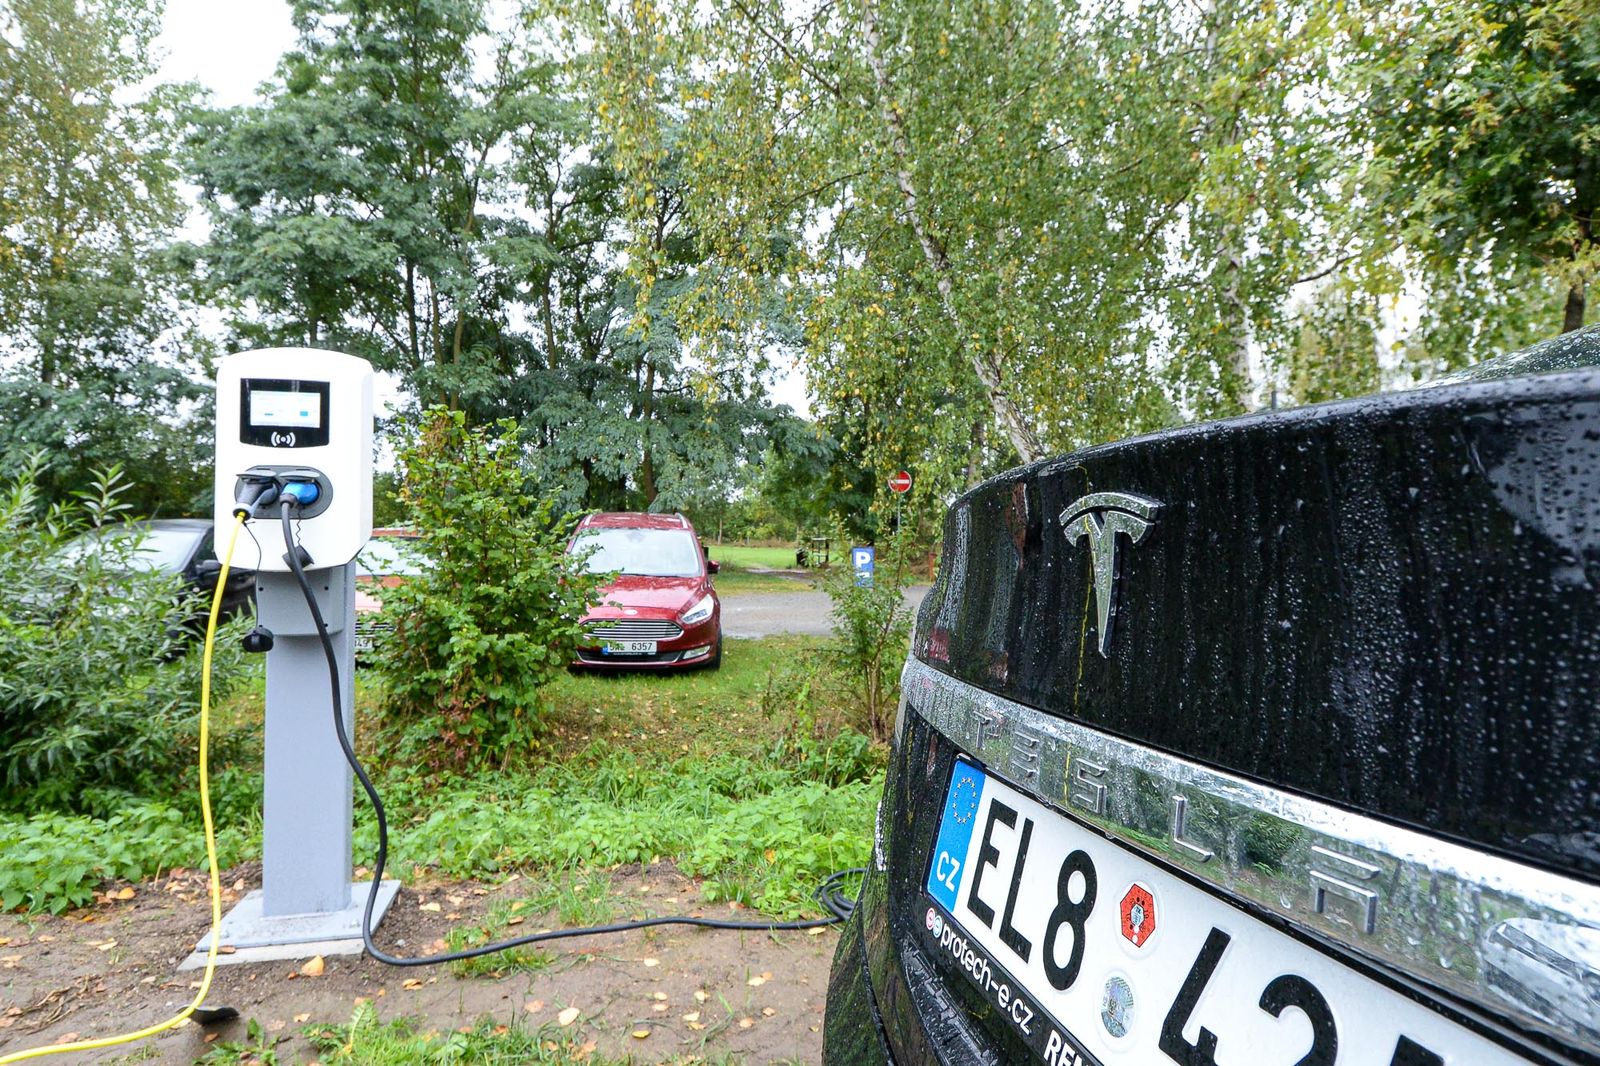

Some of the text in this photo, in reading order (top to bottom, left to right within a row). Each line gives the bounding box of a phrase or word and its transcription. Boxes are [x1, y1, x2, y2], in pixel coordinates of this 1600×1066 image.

[855, 551, 871, 569] P
[631, 642, 653, 651] 6357
[936, 850, 960, 892] CZ
[967, 797, 1445, 1066] EL8 42
[940, 923, 1034, 1036] protech-e.cz
